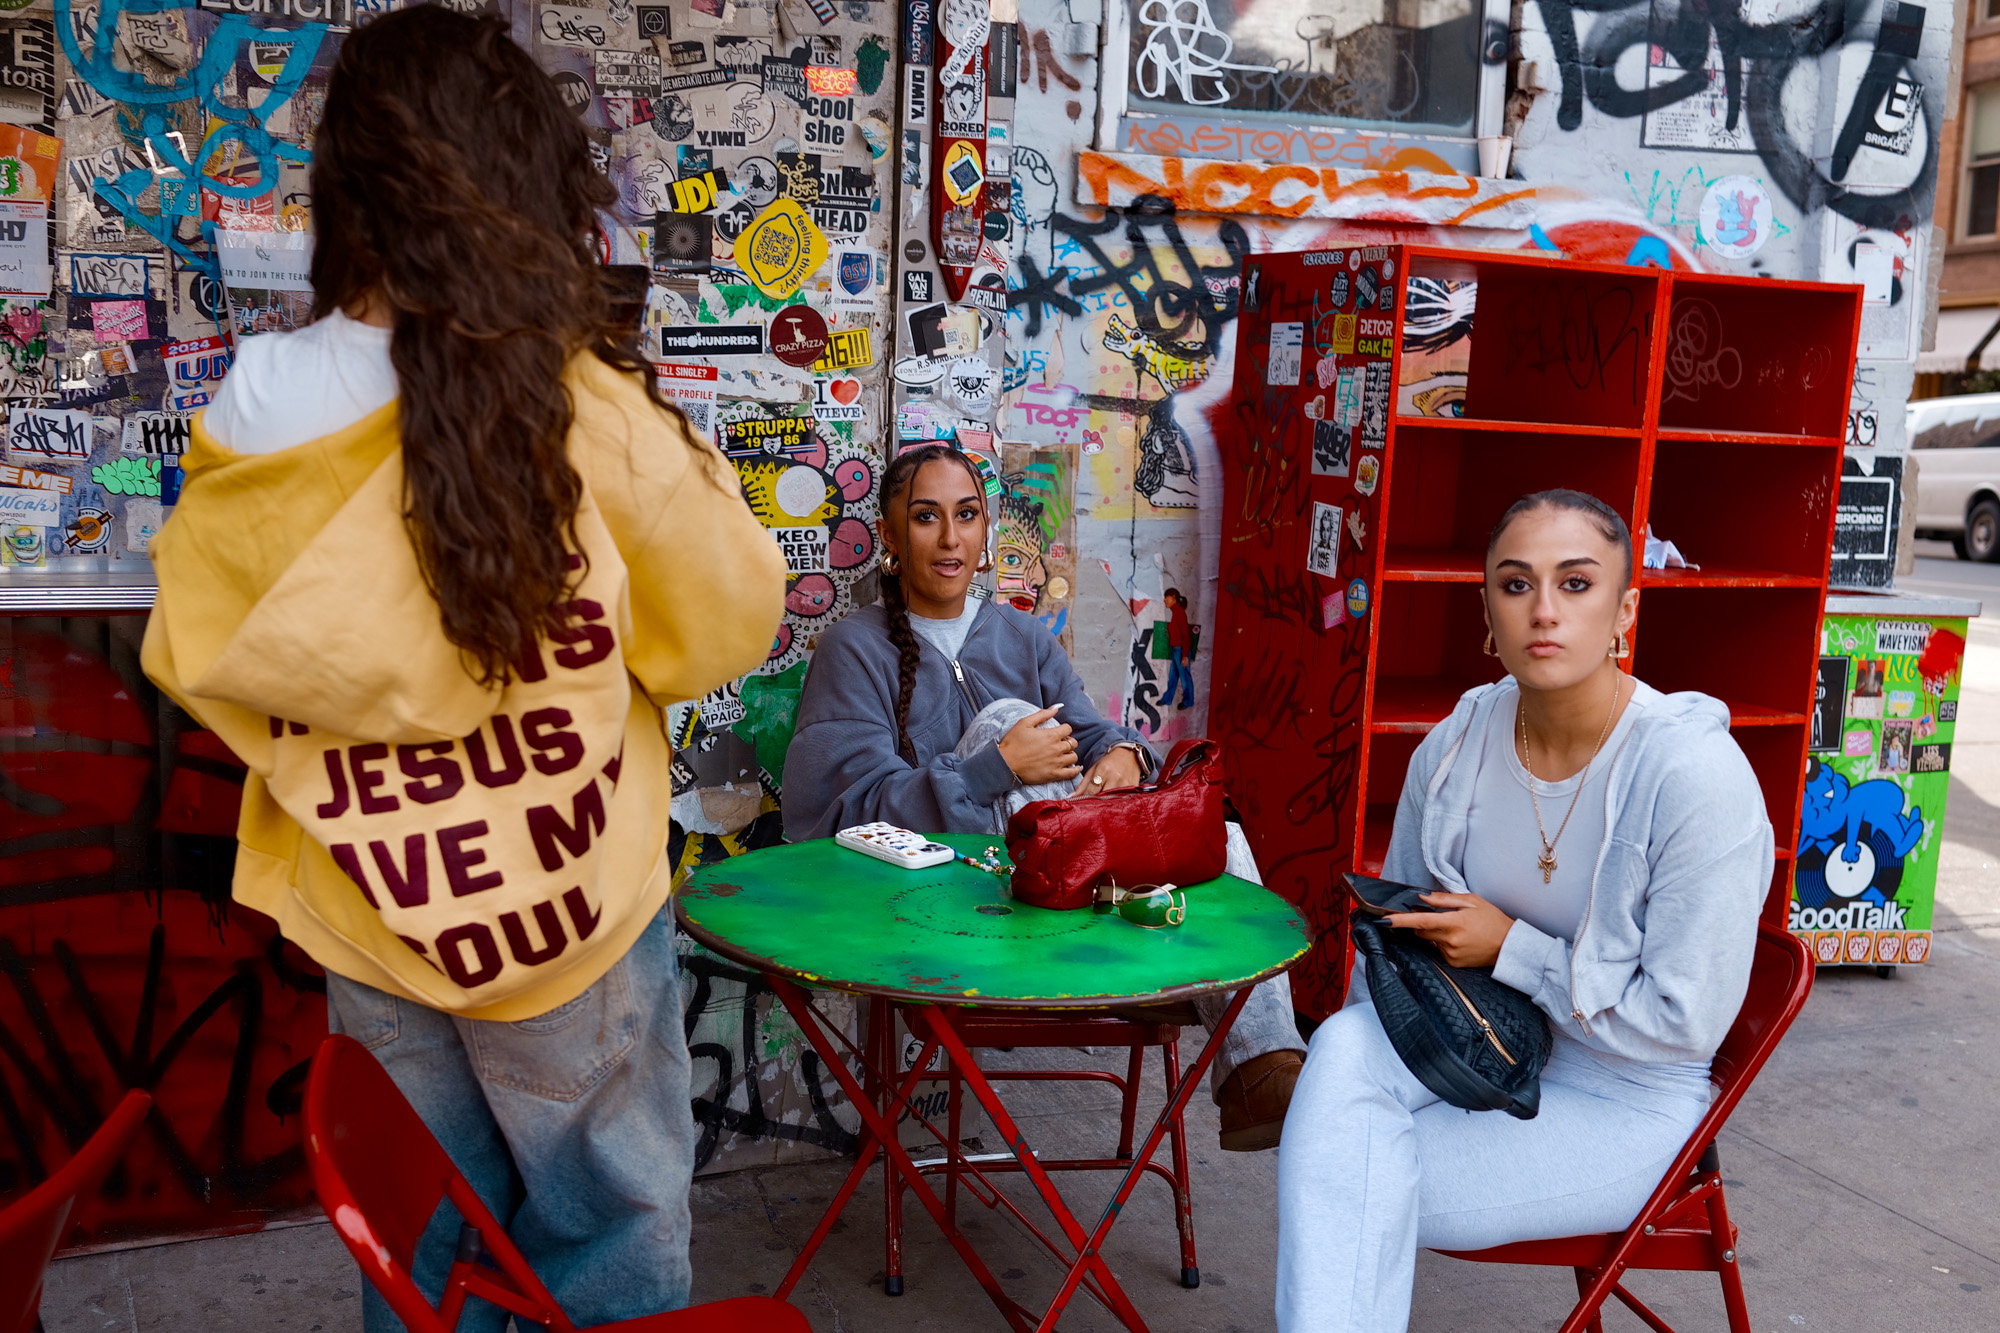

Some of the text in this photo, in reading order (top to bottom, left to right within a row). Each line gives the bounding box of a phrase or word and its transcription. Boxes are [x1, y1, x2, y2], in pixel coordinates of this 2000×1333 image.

[764, 64, 805, 84] STREETS
[807, 97, 854, 121] cool
[805, 120, 844, 145] she
[941, 121, 984, 133] BORED
[814, 209, 867, 233] HEAD
[95, 232, 125, 244] BASTA
[250, 270, 267, 280] JOIN
[271, 271, 285, 281] THE
[842, 261, 868, 280] GSV
[908, 272, 926, 283] GAL
[908, 282, 927, 291] VAN
[912, 291, 928, 300] IZE
[1360, 319, 1393, 336] DETOR
[168, 340, 211, 356] 2024
[667, 337, 687, 347] THE
[775, 339, 825, 353] CRAZY PIZZA
[675, 366, 708, 378] SINGLE?
[679, 388, 713, 400] PROFILE
[815, 407, 860, 419] VIEVE
[736, 418, 807, 438] STRUPPA
[745, 435, 800, 448] 19 86
[776, 529, 816, 542] KEO
[1878, 632, 1926, 652] WAVEYISM
[317, 707, 585, 819] JESUS
